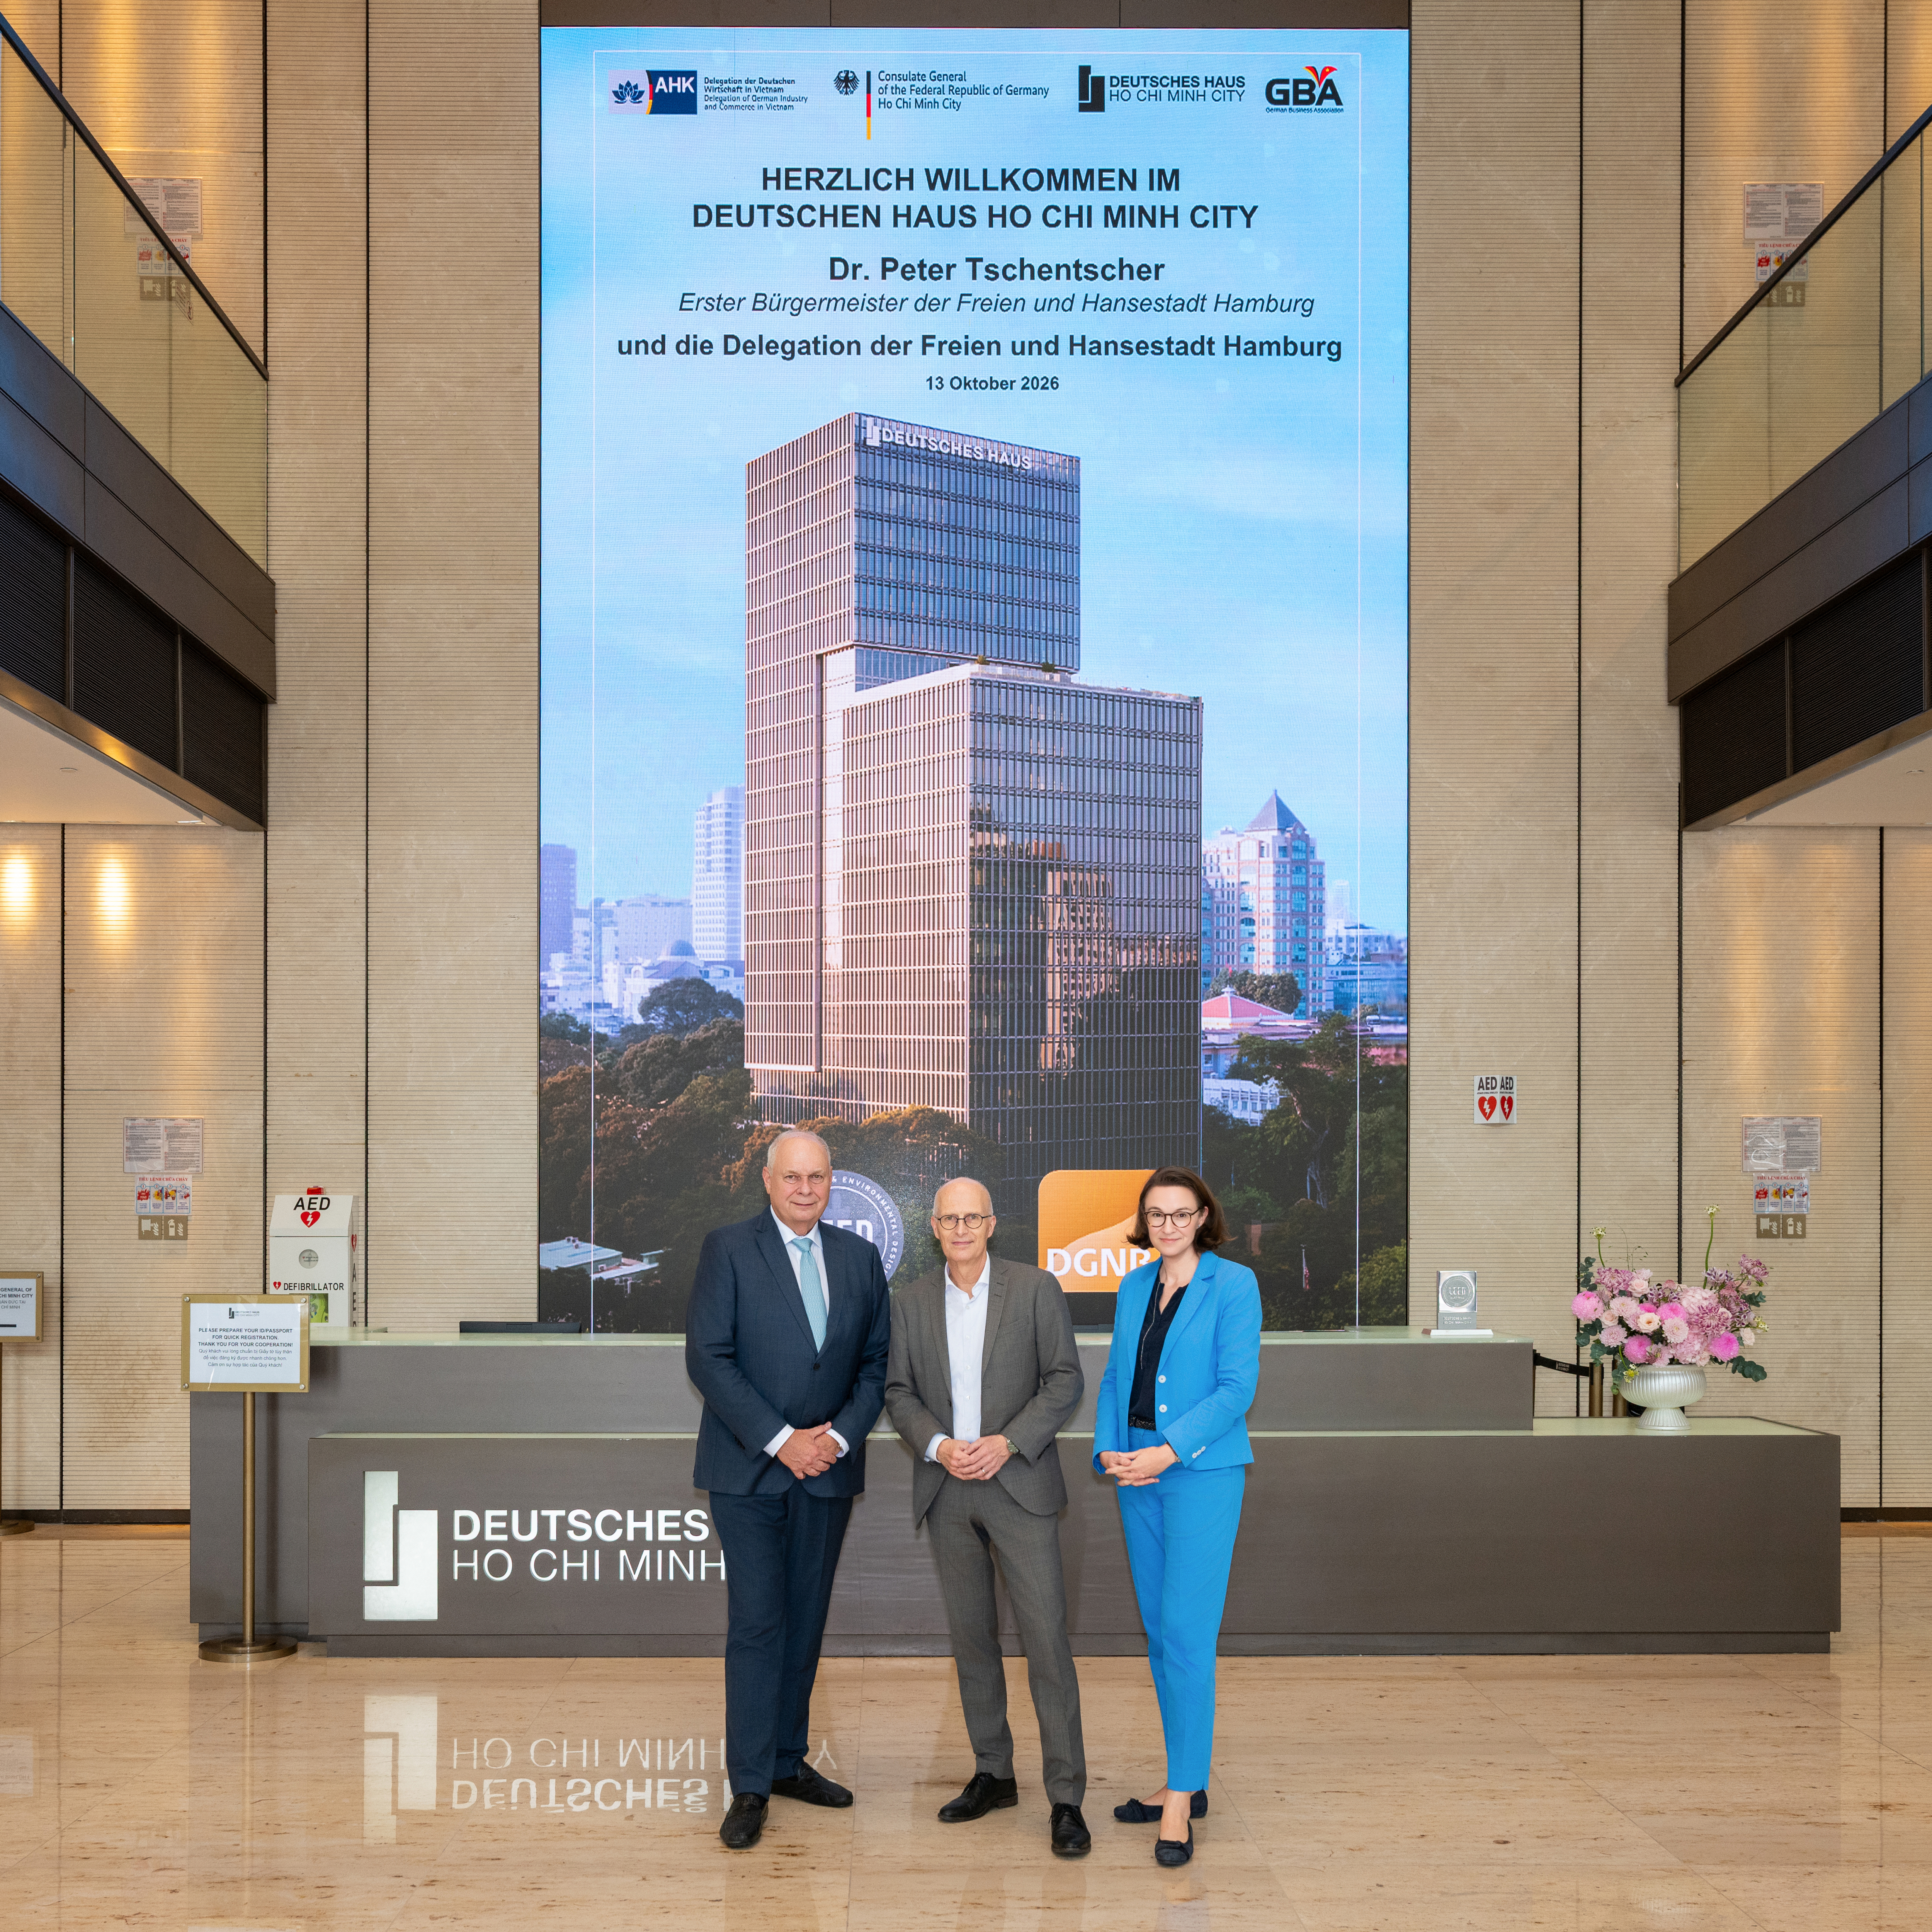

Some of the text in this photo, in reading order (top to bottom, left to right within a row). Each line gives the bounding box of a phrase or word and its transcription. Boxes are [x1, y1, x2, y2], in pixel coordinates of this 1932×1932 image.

[704, 77, 742, 86] Delegation
[878, 70, 966, 82] Consulate General
[1110, 76, 1245, 88] DEUTSCHES HAUS
[655, 77, 695, 94] AHK
[878, 83, 1049, 99] of the Federal Republic of Germany
[1265, 79, 1343, 105] GBA
[704, 95, 740, 103] Delegation
[780, 95, 808, 103] Industry
[1110, 90, 1245, 102] HO CHI MINH CITY
[878, 97, 961, 112] Ho Chi Minh City
[762, 168, 1180, 191] HERZLICH WILLKOMMEN IM
[693, 205, 1258, 228] DEUTSCHEN HAUS HO CHI MINH CITY
[830, 257, 1165, 281] Dr. Peter Tschentscher
[679, 293, 1314, 317] Erster Bürgermeister der Freien und Hansestadt Hamburg
[618, 335, 1342, 361] und die Delegation der Freien und Hansestadt Hamburg
[926, 376, 1059, 390] 13 Oktober 2026
[881, 427, 1031, 469] DEUTSCHES HAUS
[1478, 1077, 1497, 1091] AED
[1500, 1077, 1514, 1090] AED
[293, 1197, 330, 1210] AED
[843, 1177, 898, 1235] ENVIRONMENTAL
[453, 1509, 709, 1542] DEUTSCHES
[453, 1549, 726, 1582] HO CHI MINH
